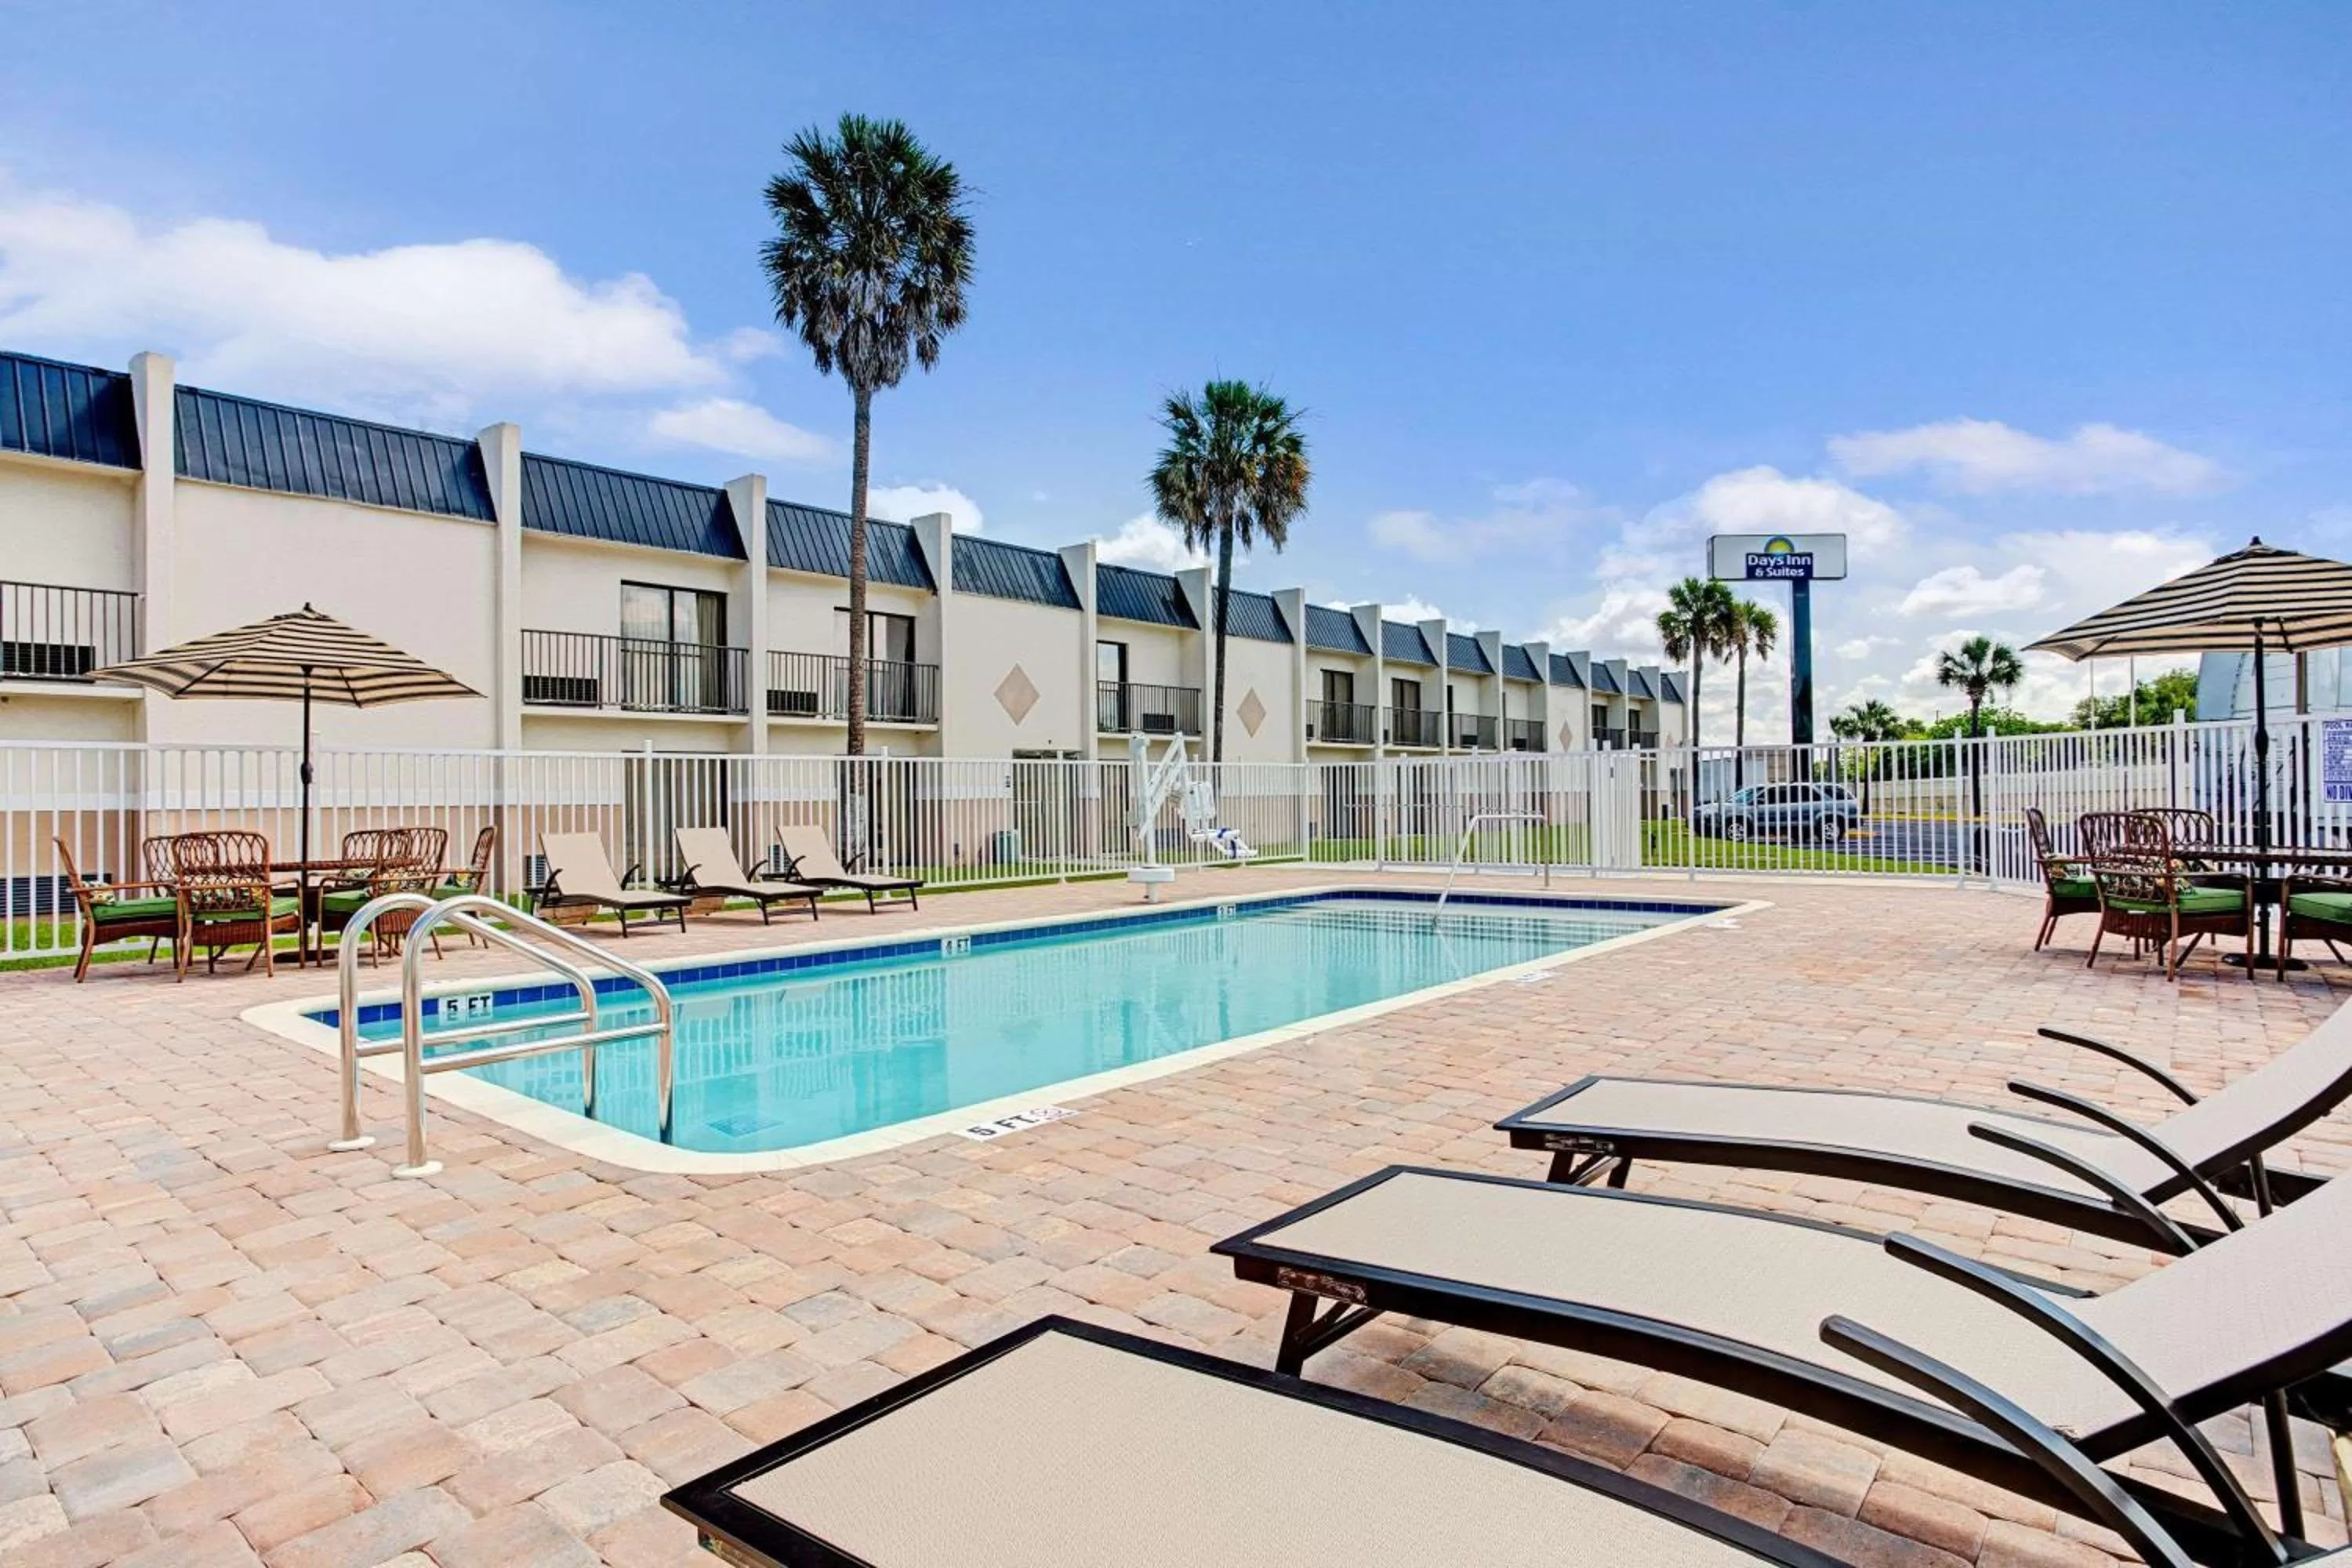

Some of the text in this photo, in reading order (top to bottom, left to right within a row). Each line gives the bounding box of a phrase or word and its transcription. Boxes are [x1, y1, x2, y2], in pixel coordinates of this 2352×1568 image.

[1748, 554, 1811, 566] Days Inn
[1755, 567, 1805, 577] & Suites
[2326, 785, 2337, 800] NO
[446, 995, 491, 1012] 5 FT
[967, 1126, 996, 1136] 5
